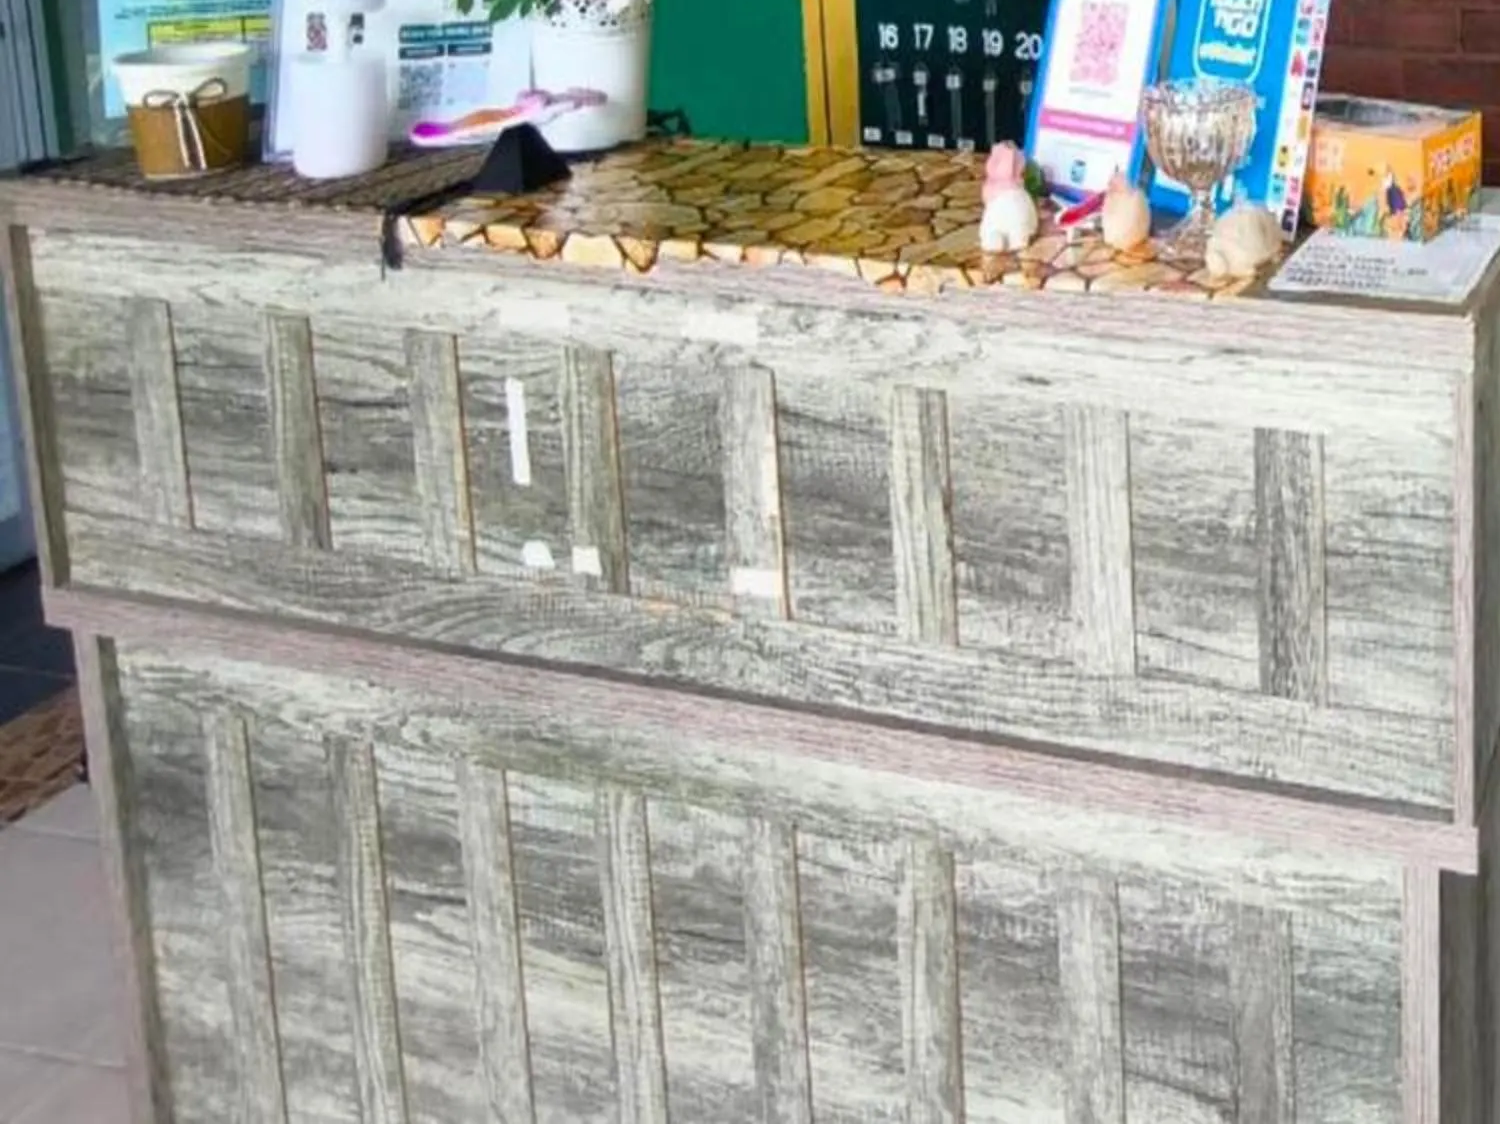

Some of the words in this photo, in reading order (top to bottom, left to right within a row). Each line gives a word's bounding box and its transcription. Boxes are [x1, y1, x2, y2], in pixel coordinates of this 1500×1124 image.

[878, 22, 899, 50] 16
[913, 22, 934, 50] 17
[947, 26, 968, 53] 18
[982, 29, 1004, 57] 19
[1014, 33, 1044, 60] 20
